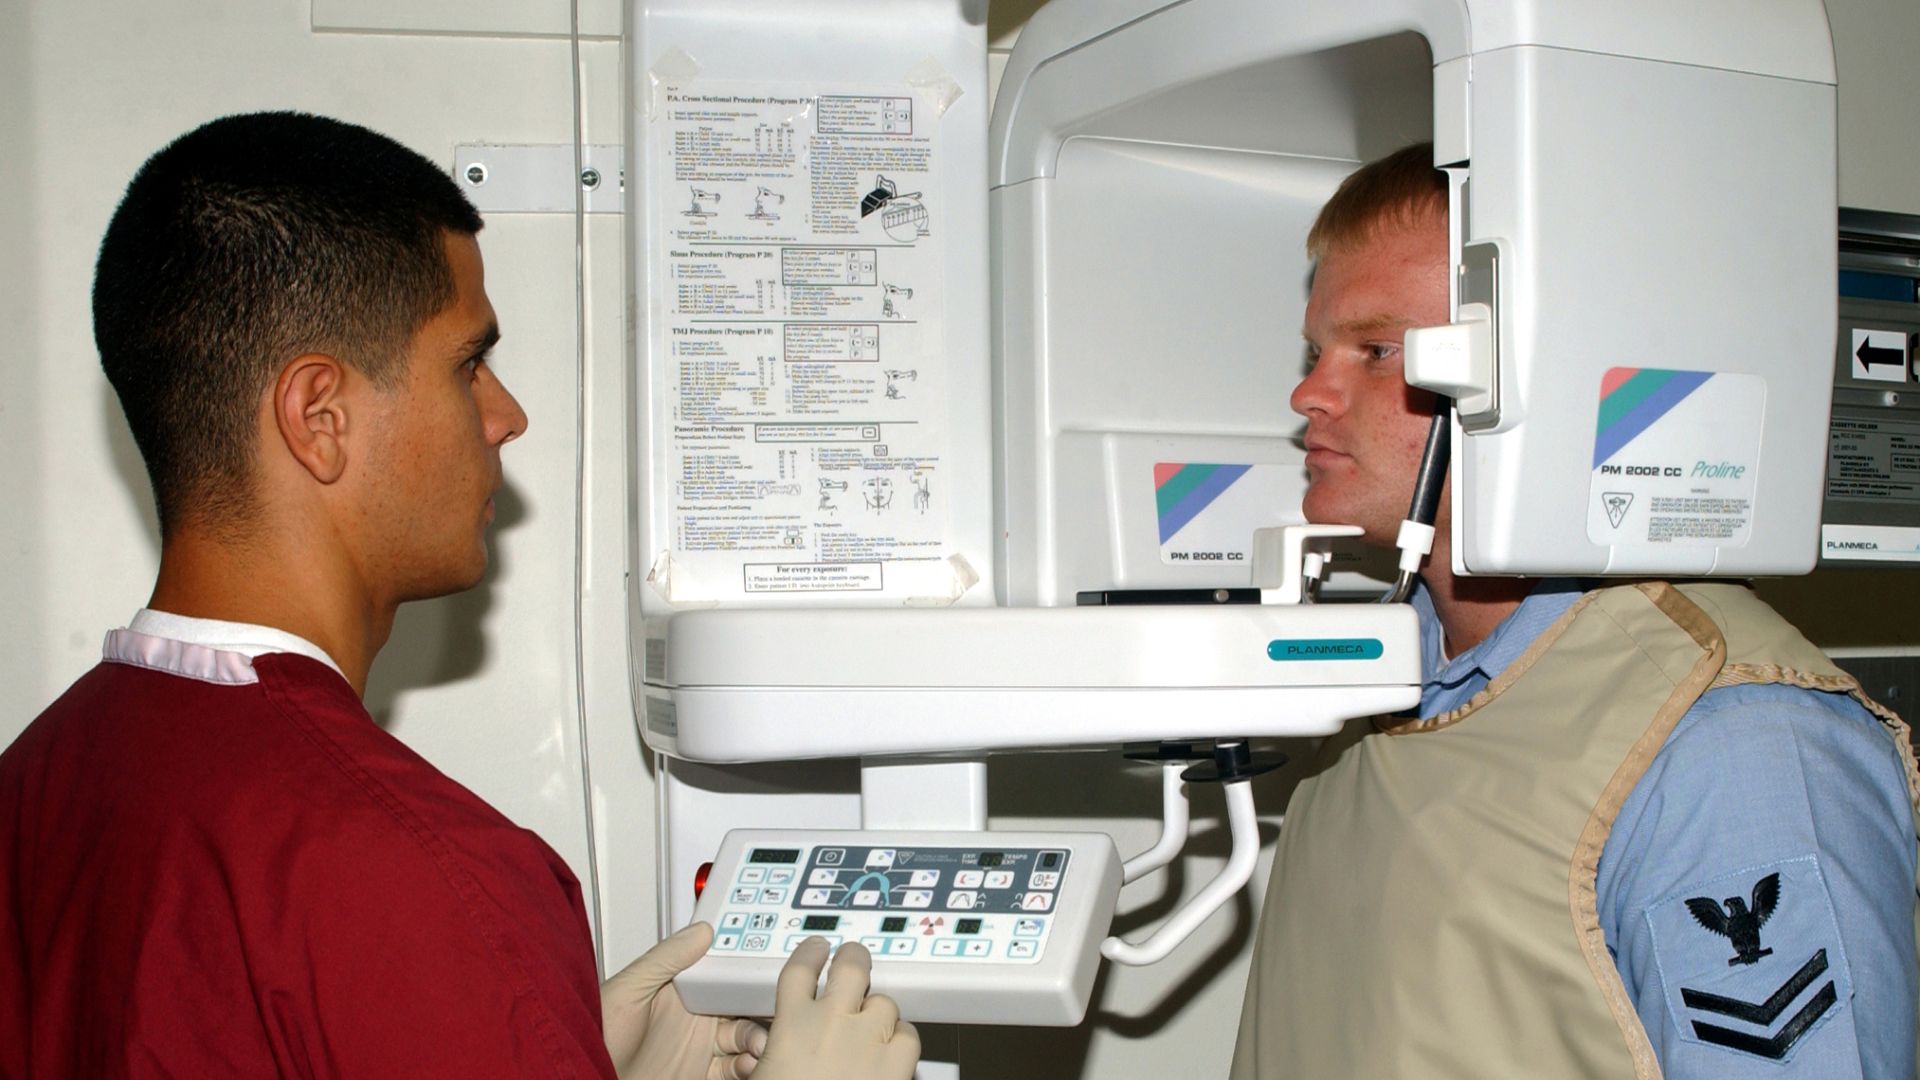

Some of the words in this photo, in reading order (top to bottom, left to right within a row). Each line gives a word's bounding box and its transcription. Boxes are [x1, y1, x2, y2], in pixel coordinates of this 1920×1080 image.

[667, 95, 680, 103] P.A.
[682, 95, 700, 103] Cross
[702, 95, 732, 104] Sectional
[733, 96, 765, 104] Procedure
[767, 96, 798, 106] (Program
[670, 250, 688, 258] Sinus
[690, 250, 723, 258] Procedure
[725, 251, 756, 259] (Program
[725, 328, 756, 336] (Program
[1601, 465, 1622, 475] PM
[1625, 466, 1660, 476] 2002
[1664, 467, 1682, 477] CC
[1690, 460, 1746, 480] Proline
[1827, 541, 1878, 550] PLANMECA
[1170, 552, 1189, 560] PM
[1192, 552, 1223, 560] 2002
[1227, 552, 1243, 560] CC
[777, 566, 790, 574] For
[791, 566, 810, 575] every
[812, 565, 848, 574] exposure:
[1287, 645, 1364, 655] PLANMECA
